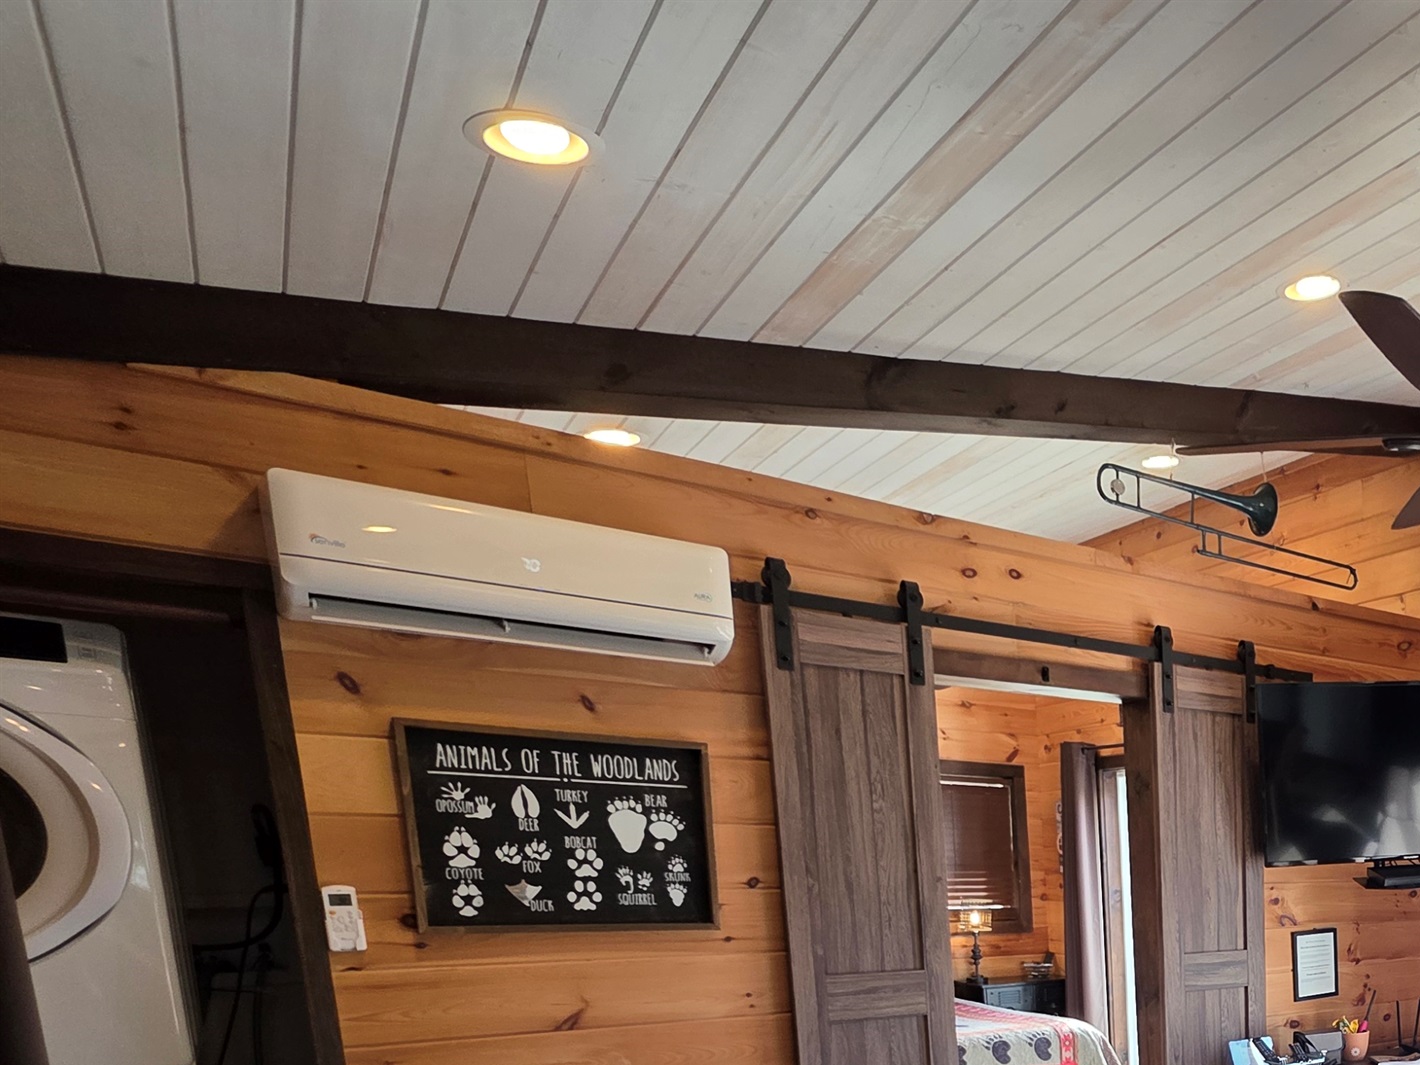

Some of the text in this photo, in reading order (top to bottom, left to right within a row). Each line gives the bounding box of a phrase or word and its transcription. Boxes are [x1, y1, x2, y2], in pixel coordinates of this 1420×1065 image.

[435, 742, 680, 782] ANIMALS OF THE WOODLANDS
[554, 788, 589, 803] TURKEY
[644, 794, 668, 808] BEAR
[436, 799, 475, 813] OPOSSUM
[518, 818, 540, 832] DEER
[564, 835, 597, 849] BOBCAT
[445, 867, 485, 881] COYOTE
[522, 860, 542, 874] FOX
[663, 871, 692, 882] SKUNK
[529, 899, 555, 912] DUCK
[617, 892, 658, 906] SQUIRREL
